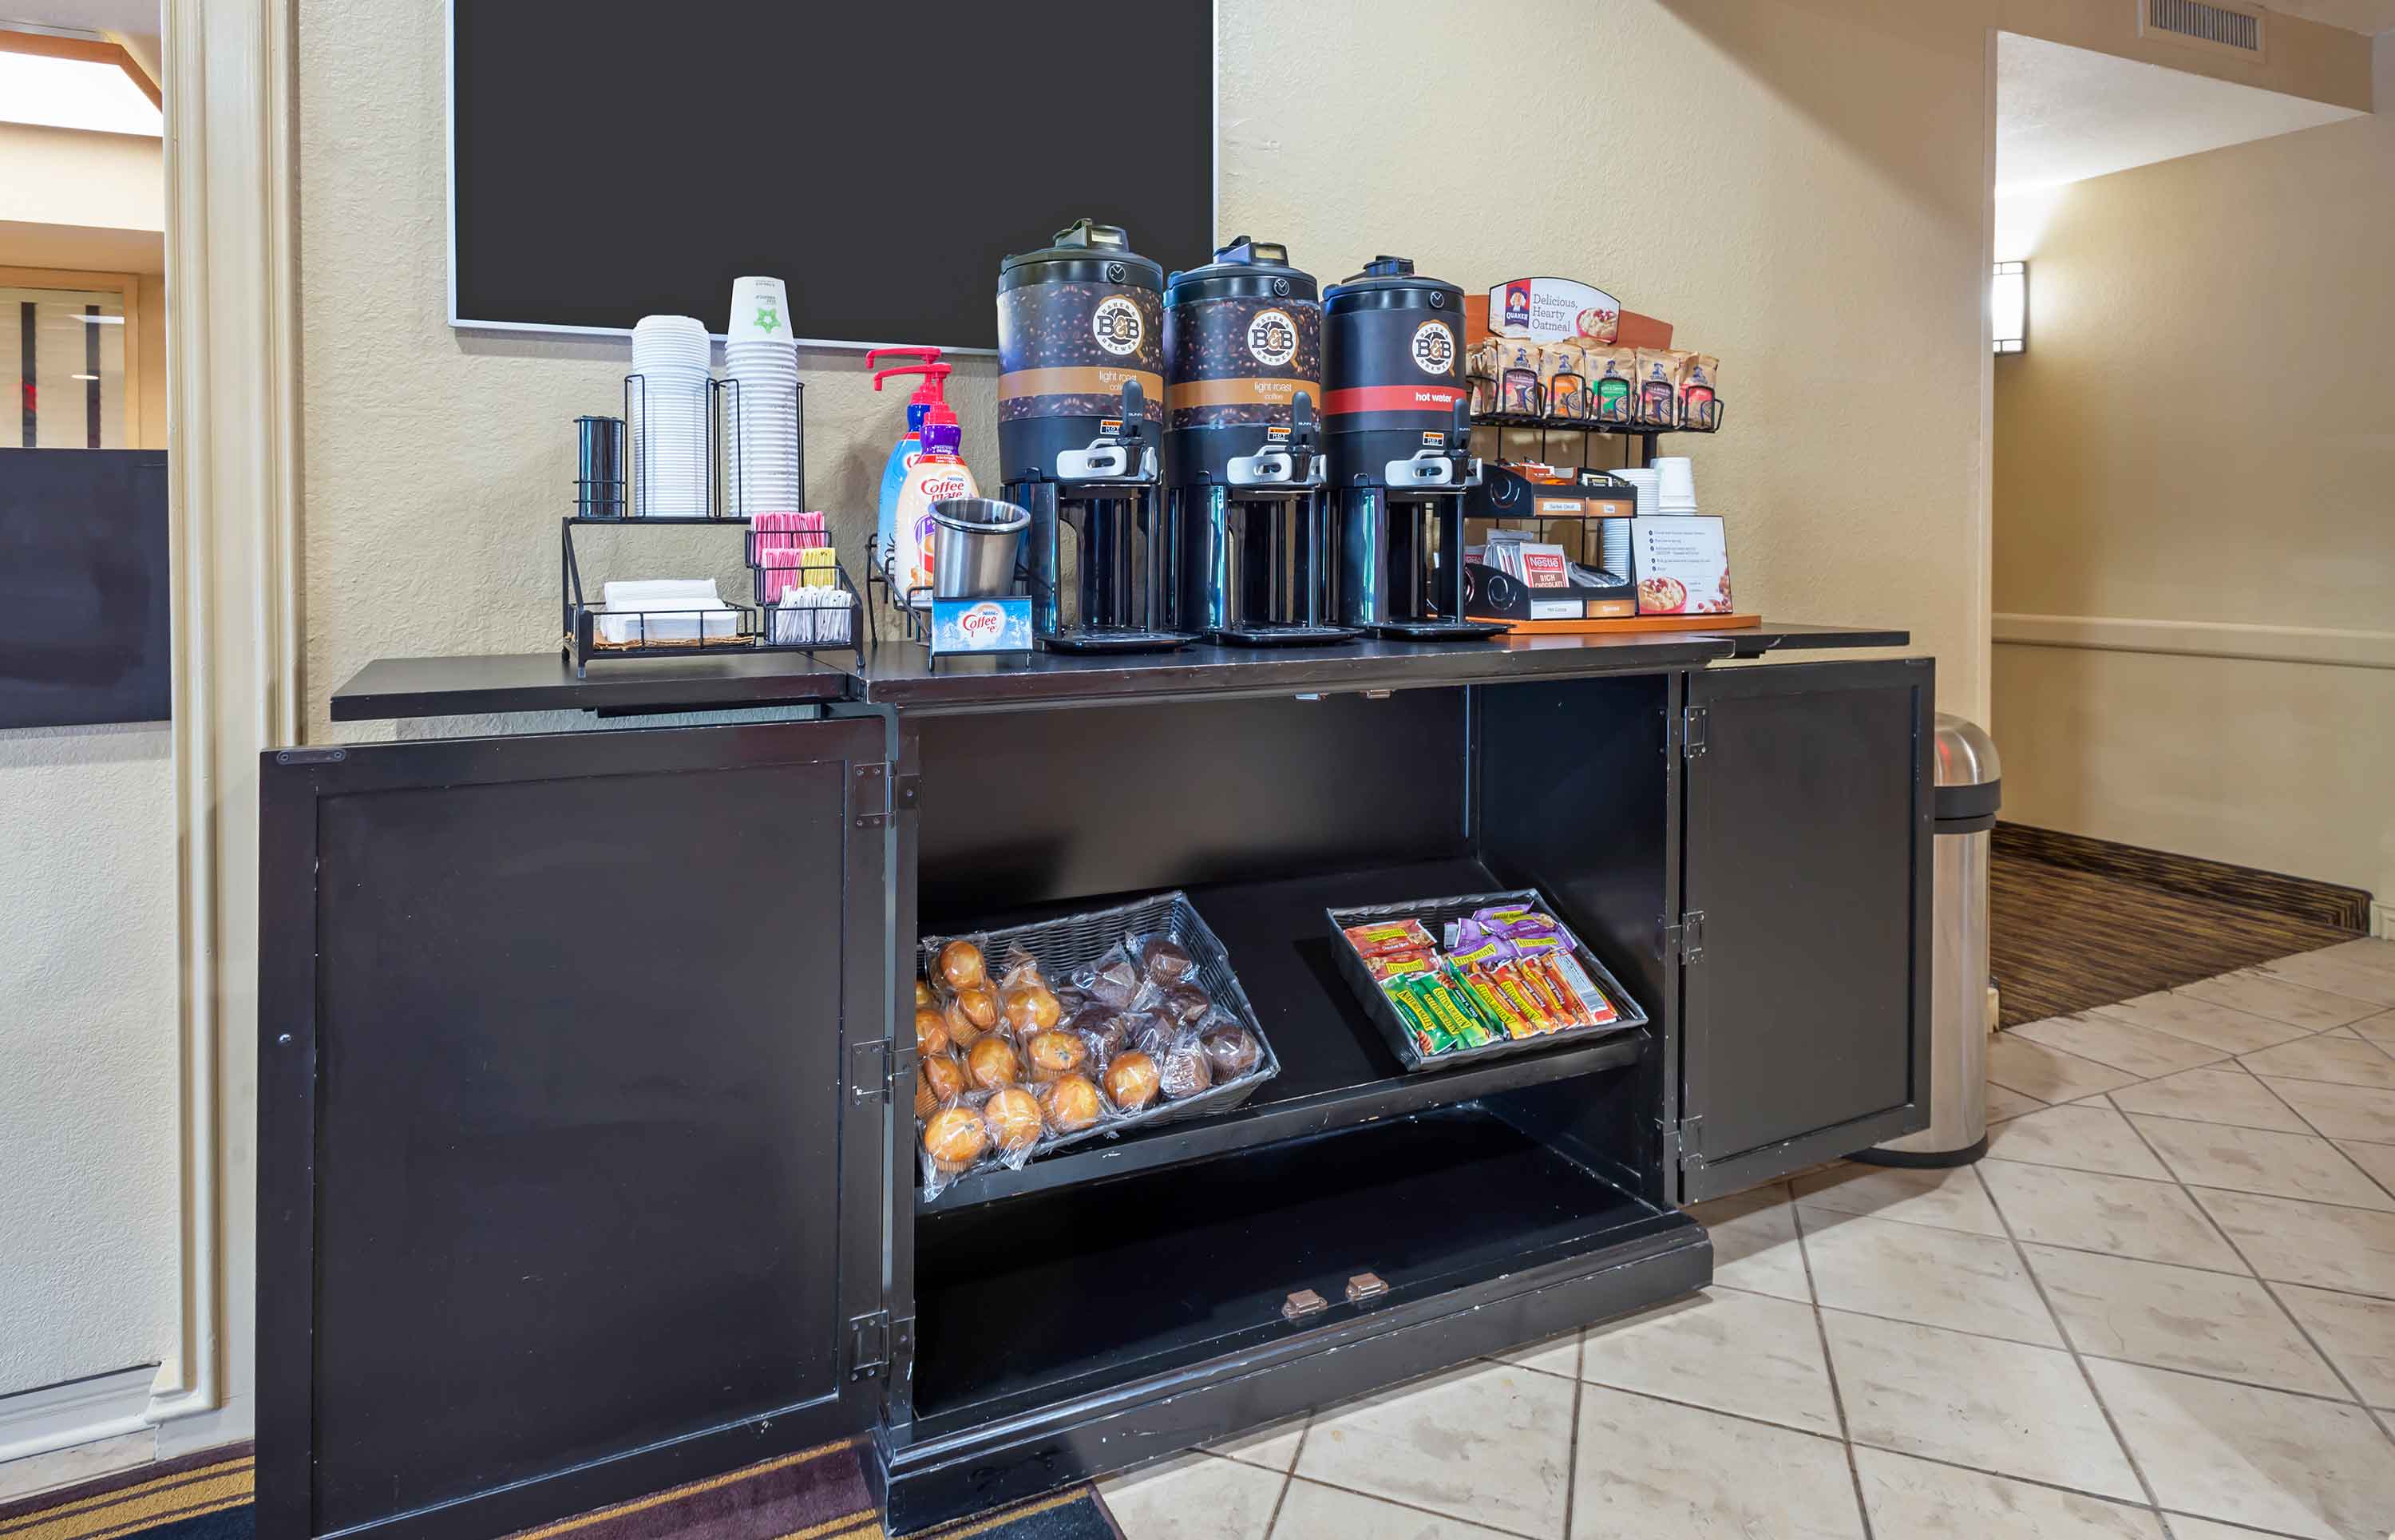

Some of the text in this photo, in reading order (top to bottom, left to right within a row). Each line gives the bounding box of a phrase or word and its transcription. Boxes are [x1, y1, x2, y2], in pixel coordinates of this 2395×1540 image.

[1534, 294, 1578, 310] Delicious,
[1506, 311, 1528, 320] QUAKER
[1532, 306, 1566, 322] Hearty
[1097, 315, 1139, 339] B&B
[1532, 319, 1571, 332] Oatmeal
[1251, 328, 1293, 350] B&B
[1415, 338, 1451, 359] B&B
[1099, 370, 1137, 382] light roast
[1254, 382, 1292, 394] light roast
[1415, 391, 1452, 403] hot water
[920, 478, 964, 495] Coffee
[963, 614, 997, 631] Coffee
[1501, 981, 1520, 1003] VALLEY
[1522, 980, 1534, 994] Butter
[1543, 975, 1565, 1004] Peanut Butter
[1476, 984, 1514, 1022] NATURE VALLEY
[1495, 985, 1520, 1012] Peanut Butter
[1532, 992, 1546, 1008] Peanut
[1400, 990, 1435, 1031] NATURE VALLEY
[1435, 988, 1470, 1028] NATURE VALLEY
